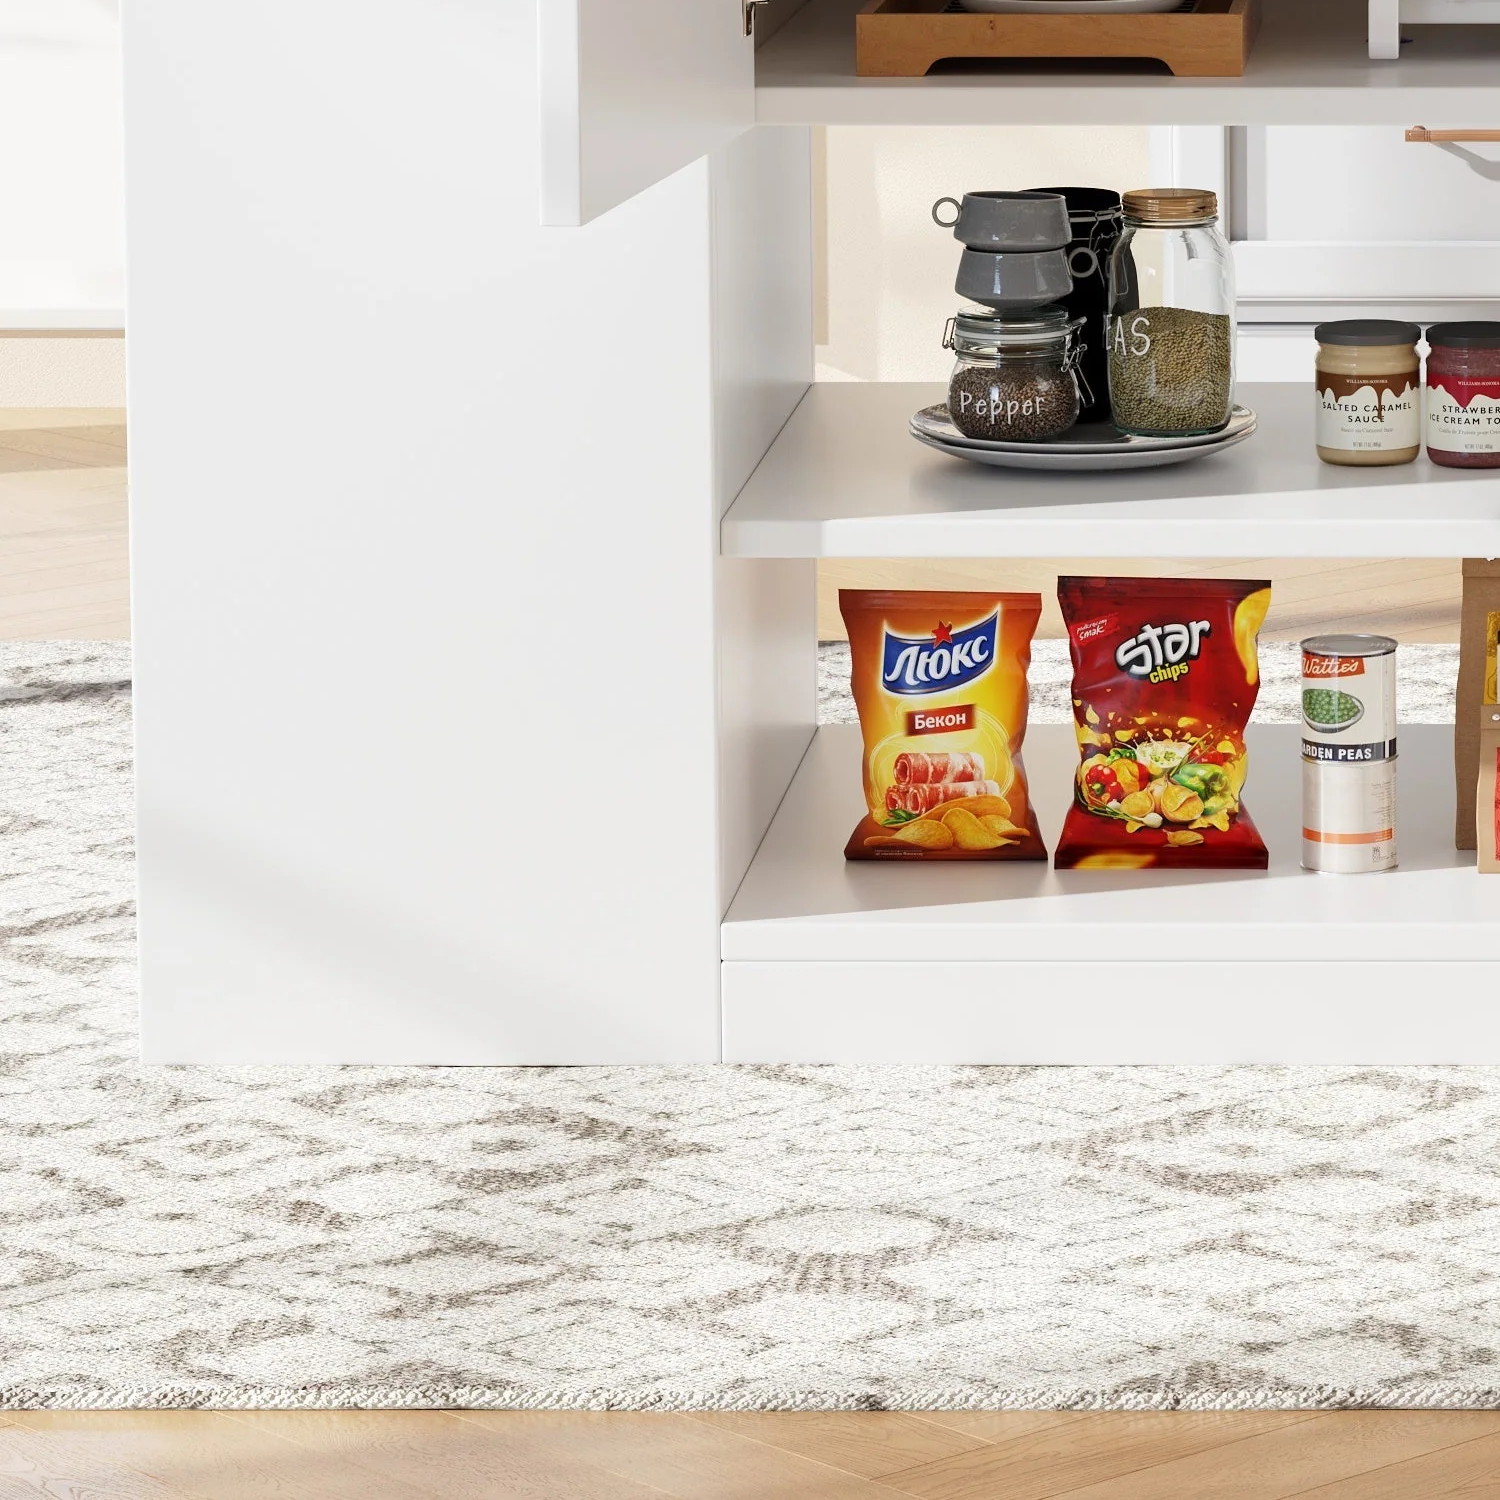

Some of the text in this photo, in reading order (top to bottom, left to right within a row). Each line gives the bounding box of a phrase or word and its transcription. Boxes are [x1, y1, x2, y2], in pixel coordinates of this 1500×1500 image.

[960, 390, 1045, 425] Pepper
[1322, 401, 1412, 412] SALTED CARAMEL
[1347, 415, 1385, 423] SAUCE
[1429, 413, 1440, 423] ICE
[1443, 416, 1480, 425] CREAM
[1079, 625, 1105, 641] smak
[1150, 661, 1189, 684] chips
[1302, 657, 1359, 675] Wattie's
[914, 712, 967, 730] Бекон
[1338, 748, 1372, 760] PEAS
